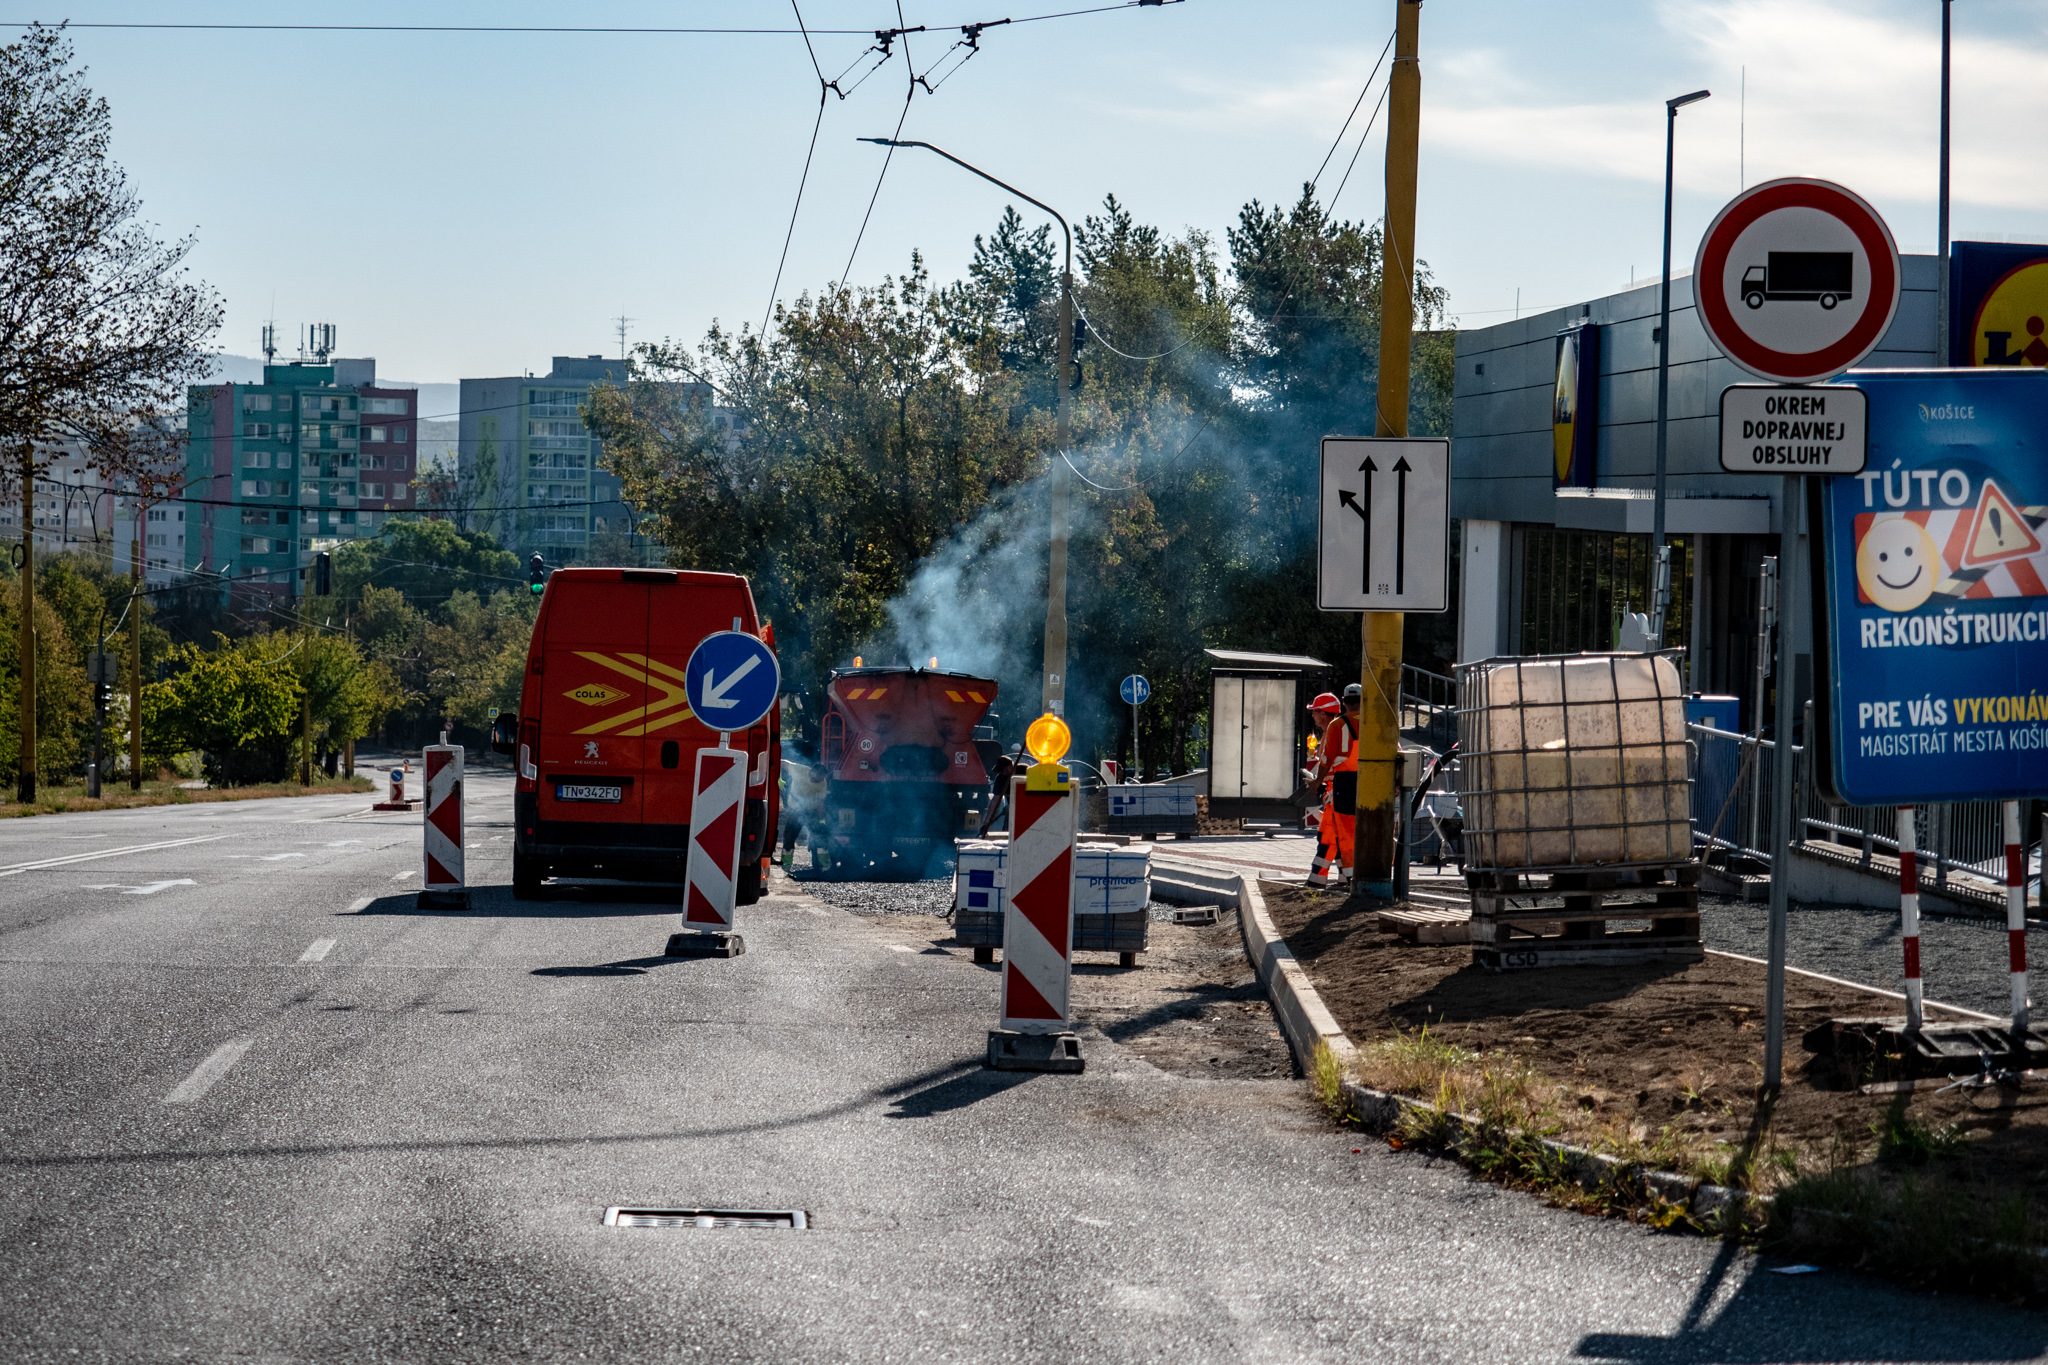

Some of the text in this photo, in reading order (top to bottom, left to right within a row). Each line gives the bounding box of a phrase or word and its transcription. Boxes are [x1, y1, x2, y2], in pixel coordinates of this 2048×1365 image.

[1765, 396, 1825, 415] OKREM
[1930, 403, 1975, 420] KOŠICE
[1743, 420, 1845, 441] DOPRAVNEJ
[1752, 445, 1832, 465] OBSLUHY
[1855, 457, 1970, 507] TÚTO
[1860, 607, 2048, 649] REKONŠTRUKCI
[575, 690, 606, 699] COLAS
[1858, 701, 1902, 730] PRE
[1907, 693, 1948, 727] VÁS
[1860, 722, 2048, 757] MAGISTRÁT MESTA KOŠI
[564, 786, 578, 797] TN
[1505, 952, 1539, 967] CSD
